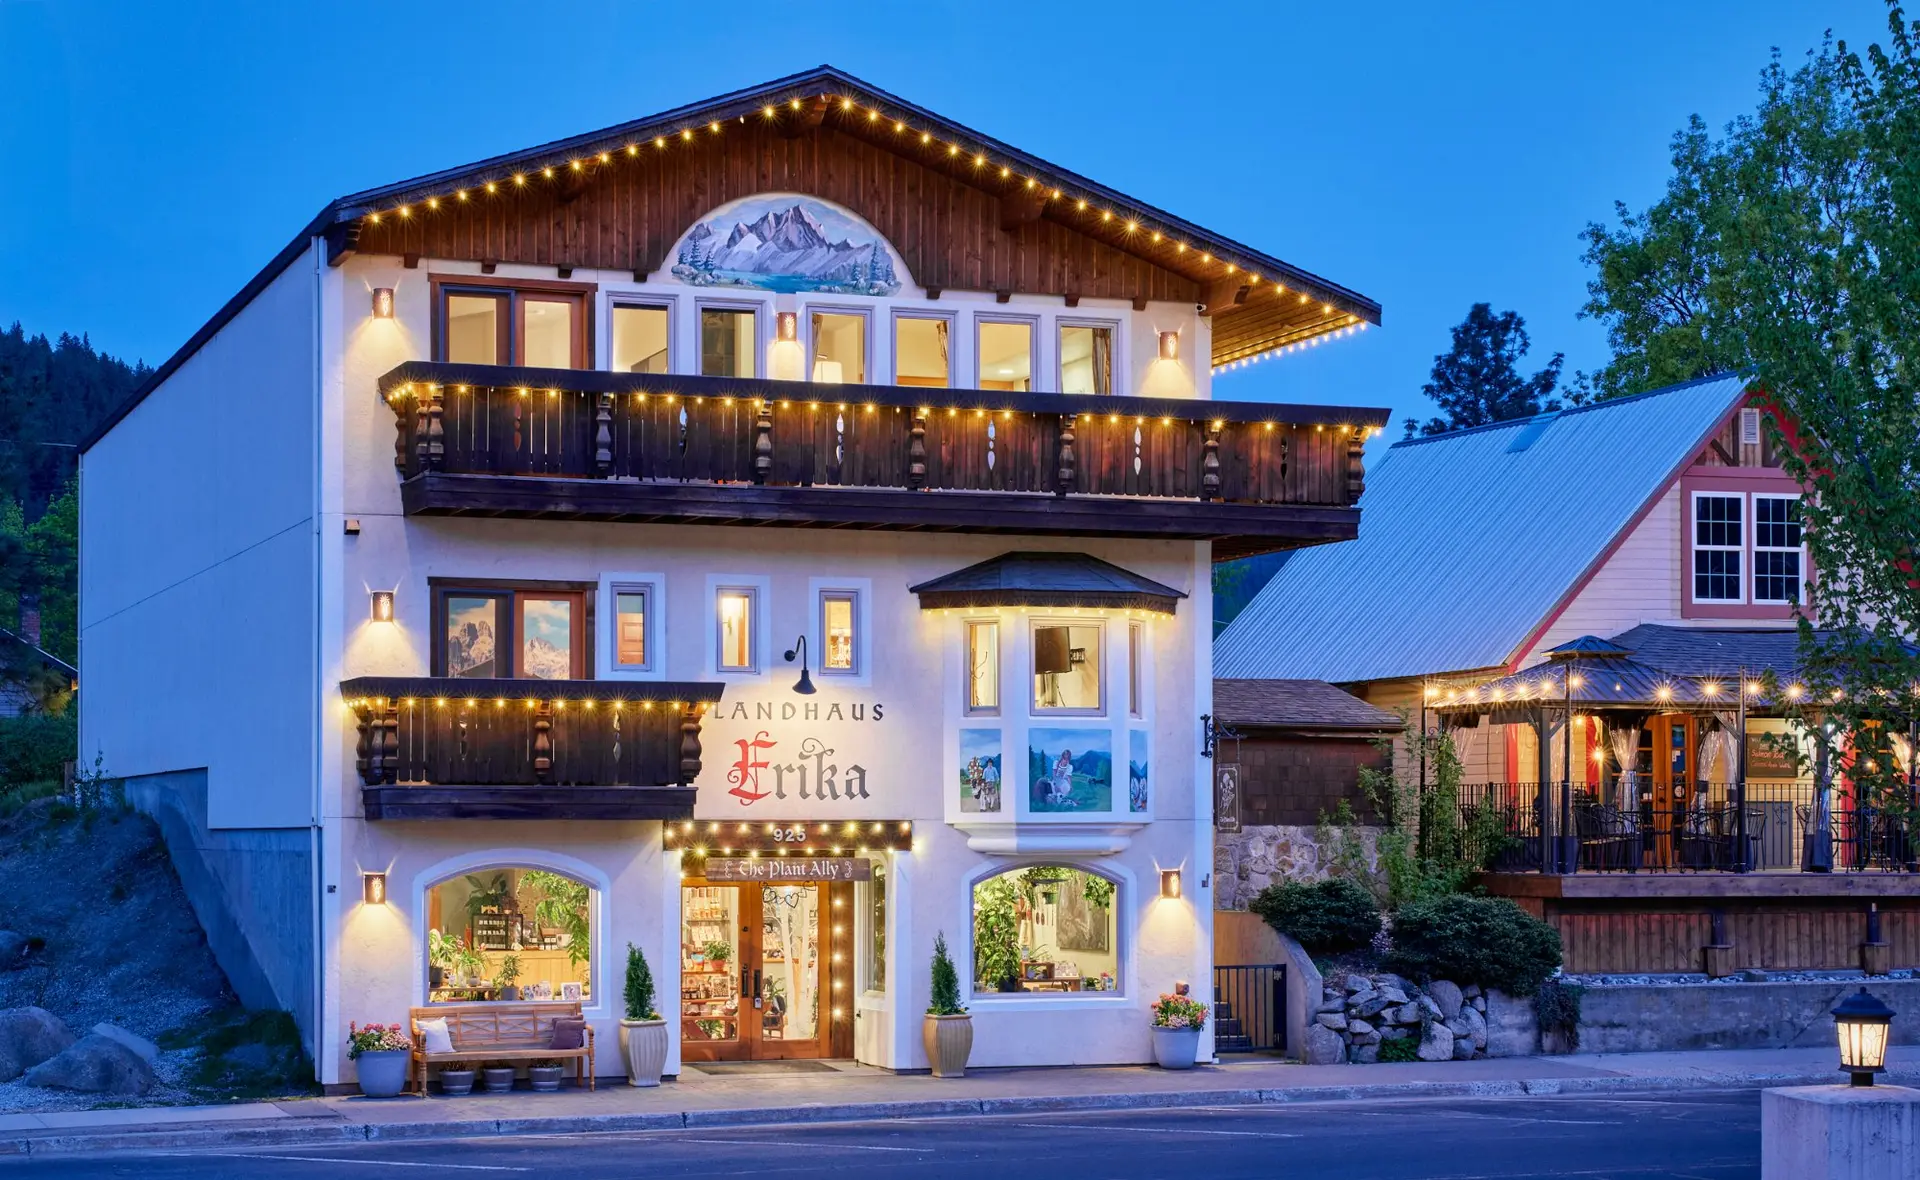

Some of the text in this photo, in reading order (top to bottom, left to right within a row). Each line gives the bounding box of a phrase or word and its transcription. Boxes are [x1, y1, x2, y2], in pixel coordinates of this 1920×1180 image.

[713, 701, 884, 721] LANDHAUS
[727, 730, 871, 806] Erika
[773, 828, 807, 842] 925
[739, 860, 839, 879] The Plant Ally
